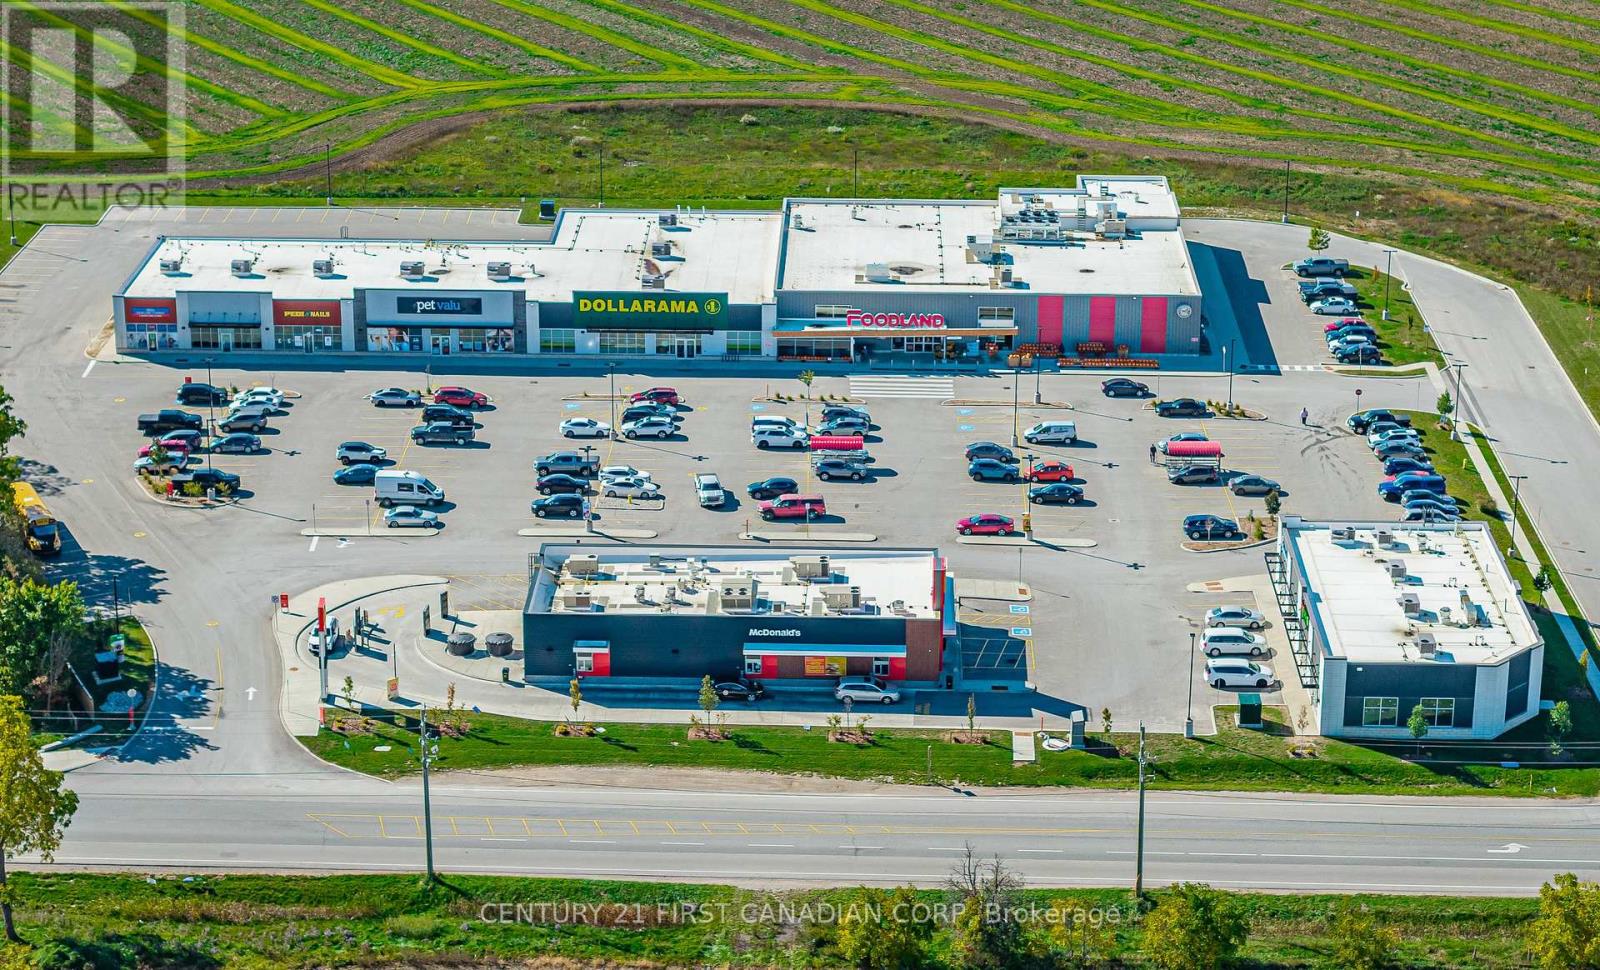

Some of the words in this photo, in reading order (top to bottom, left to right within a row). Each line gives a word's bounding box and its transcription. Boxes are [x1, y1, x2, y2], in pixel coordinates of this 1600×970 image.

[416, 299, 436, 313] pet
[436, 299, 461, 311] valu
[579, 299, 700, 313] DOLLARAMA
[310, 310, 330, 318] NAILS
[748, 628, 802, 637] McDonald's
